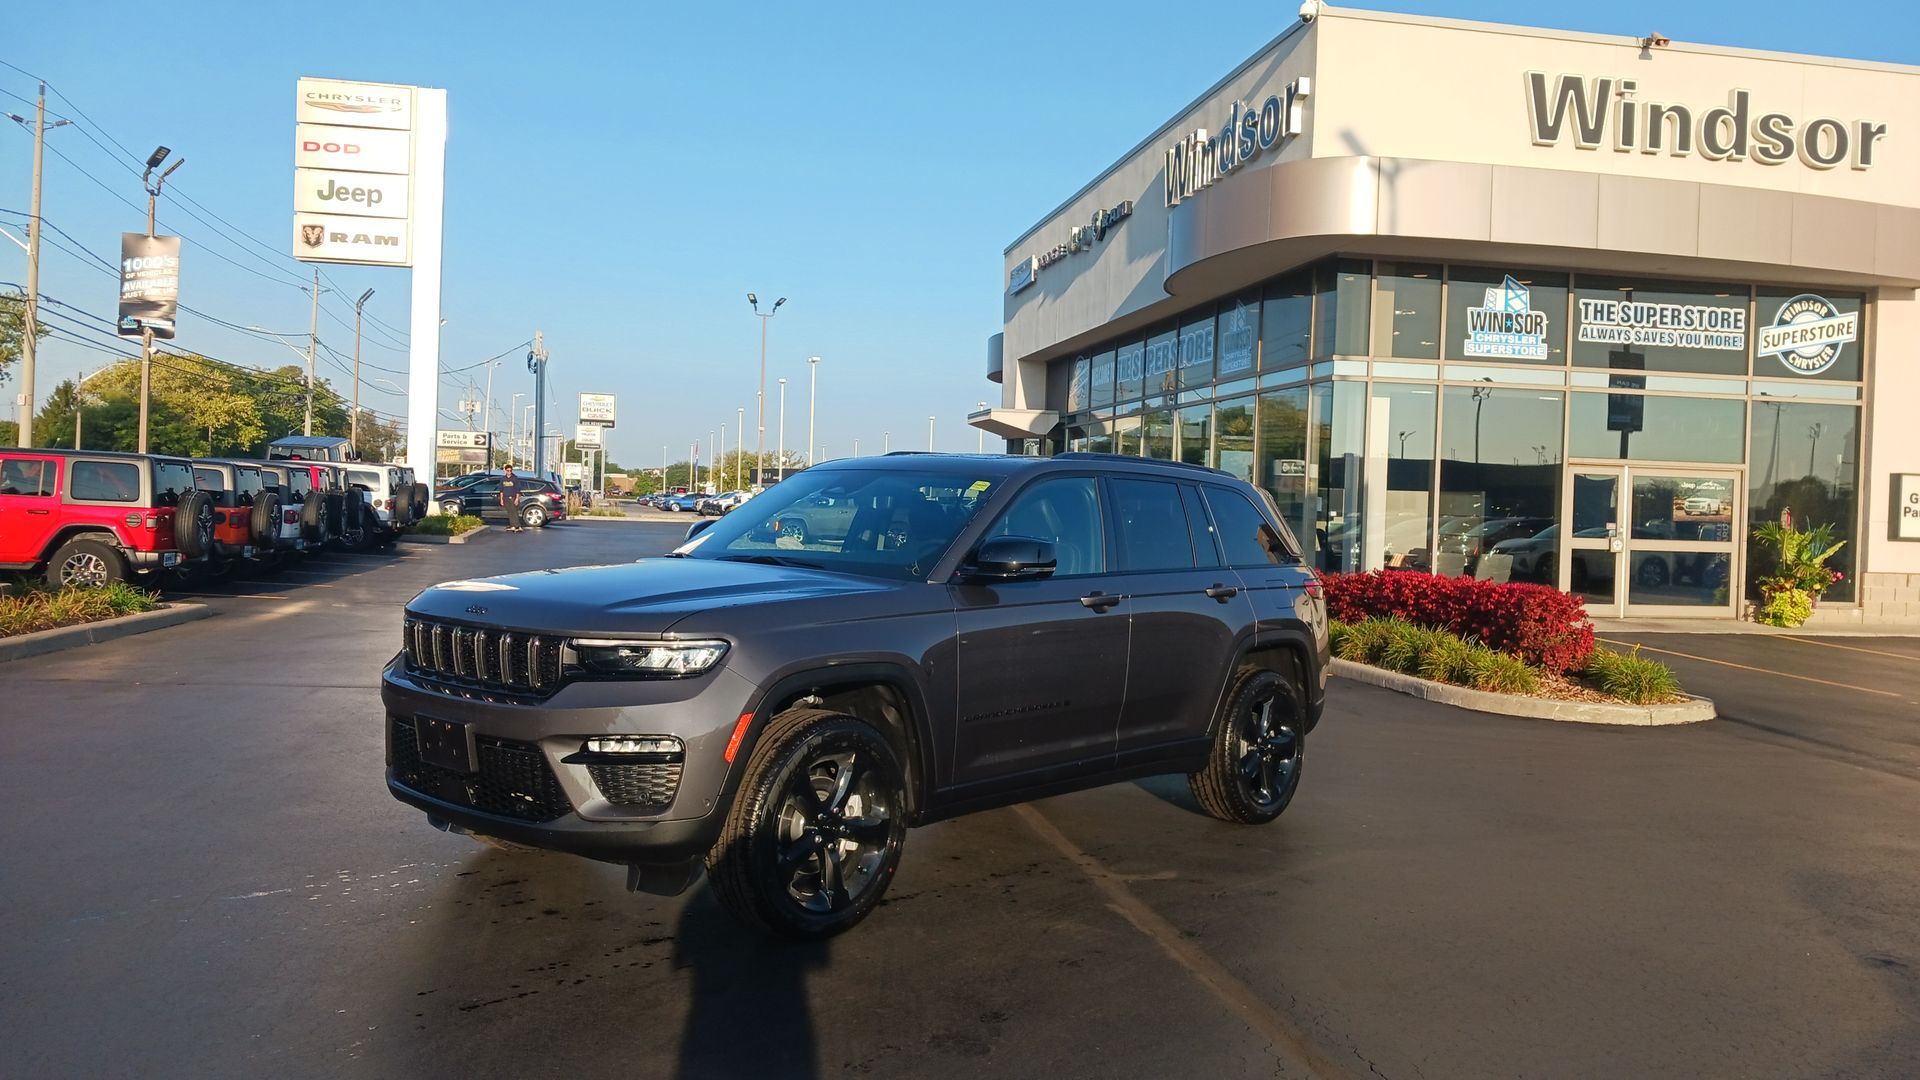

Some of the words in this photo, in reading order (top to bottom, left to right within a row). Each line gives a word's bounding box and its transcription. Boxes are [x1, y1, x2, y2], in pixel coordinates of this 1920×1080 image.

[306, 92, 401, 105] CHRYSLER
[1523, 69, 1887, 172] Windsor
[303, 141, 361, 154] DOD
[1164, 77, 1310, 208] Windsor
[317, 179, 383, 207] Jeep
[330, 231, 399, 246] RAM
[122, 291, 143, 299] JUST
[1582, 302, 1617, 322] THE
[1620, 304, 1743, 330] SUPERSTORE
[1782, 300, 1828, 322] WINDSOR
[1470, 311, 1544, 335] WINDSOR
[1475, 333, 1537, 345] CHRYSLER
[1581, 327, 1631, 341] ALWAYS
[1634, 331, 1675, 344] SAVES
[1678, 333, 1701, 345] YOU
[1704, 334, 1743, 347] MORE!
[1763, 321, 1853, 349] SUPERSTORE
[1131, 327, 1213, 380] SUPERSTORE
[1468, 344, 1544, 356] SUPERSTORE
[1788, 346, 1835, 370] CHRYSLER
[1904, 506, 1920, 518] Pa
